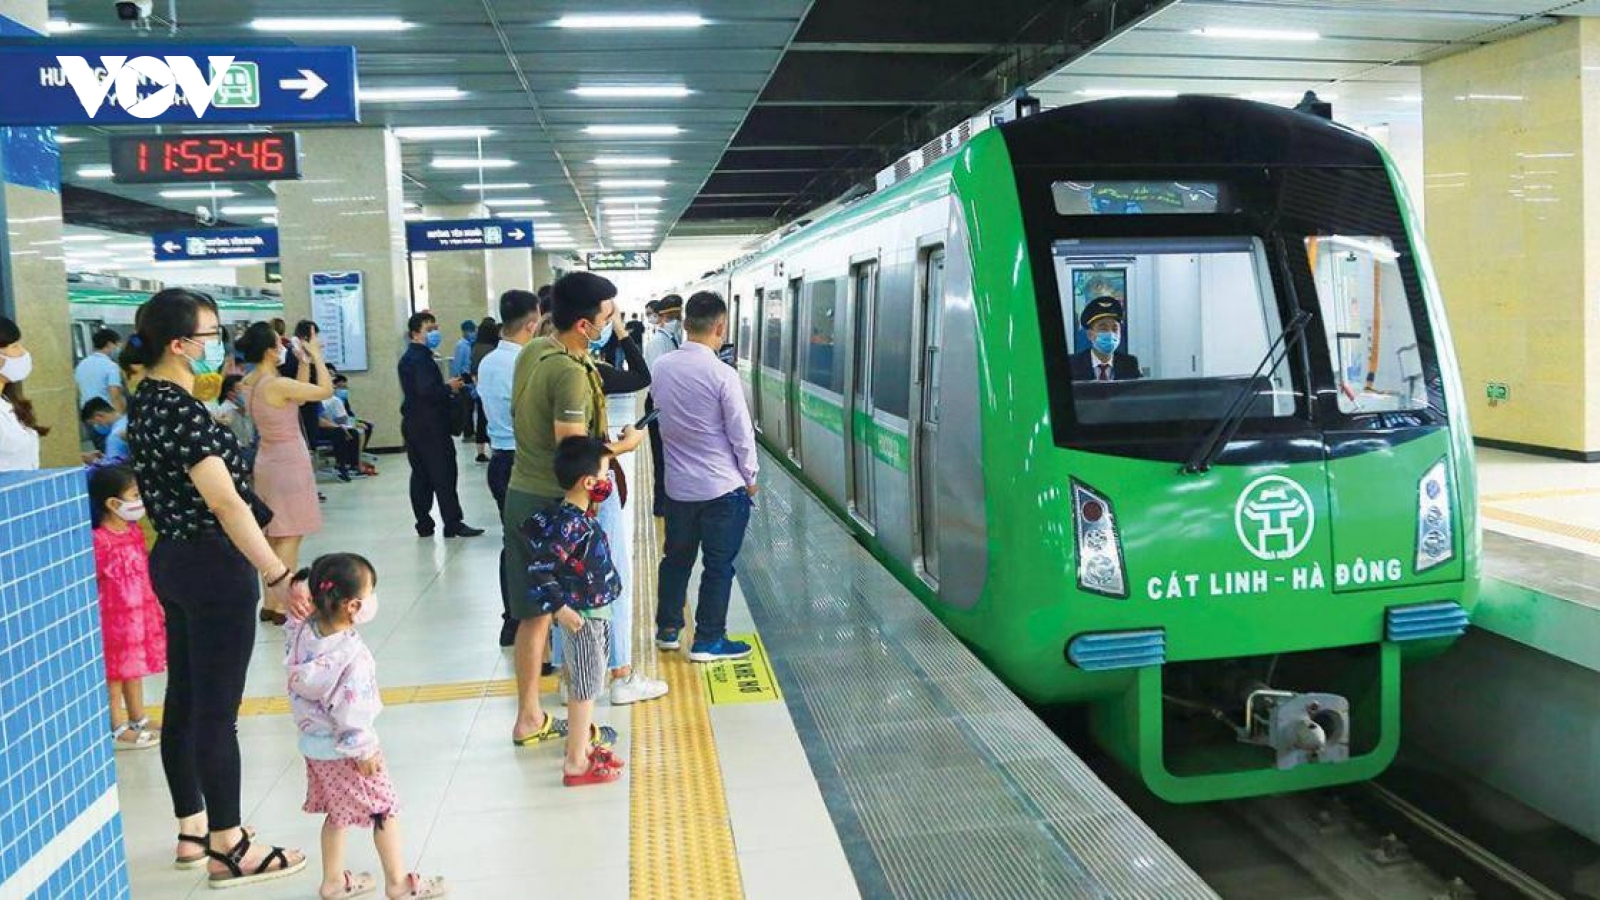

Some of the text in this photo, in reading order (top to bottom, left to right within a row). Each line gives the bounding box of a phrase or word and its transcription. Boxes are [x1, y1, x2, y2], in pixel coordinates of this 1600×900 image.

[138, 139, 283, 173] 11:52:46
[1147, 571, 1199, 600] CÁT
[1210, 570, 1268, 595] LINH
[1292, 561, 1325, 590] HÀ
[1335, 557, 1402, 587] ĐÔNG
